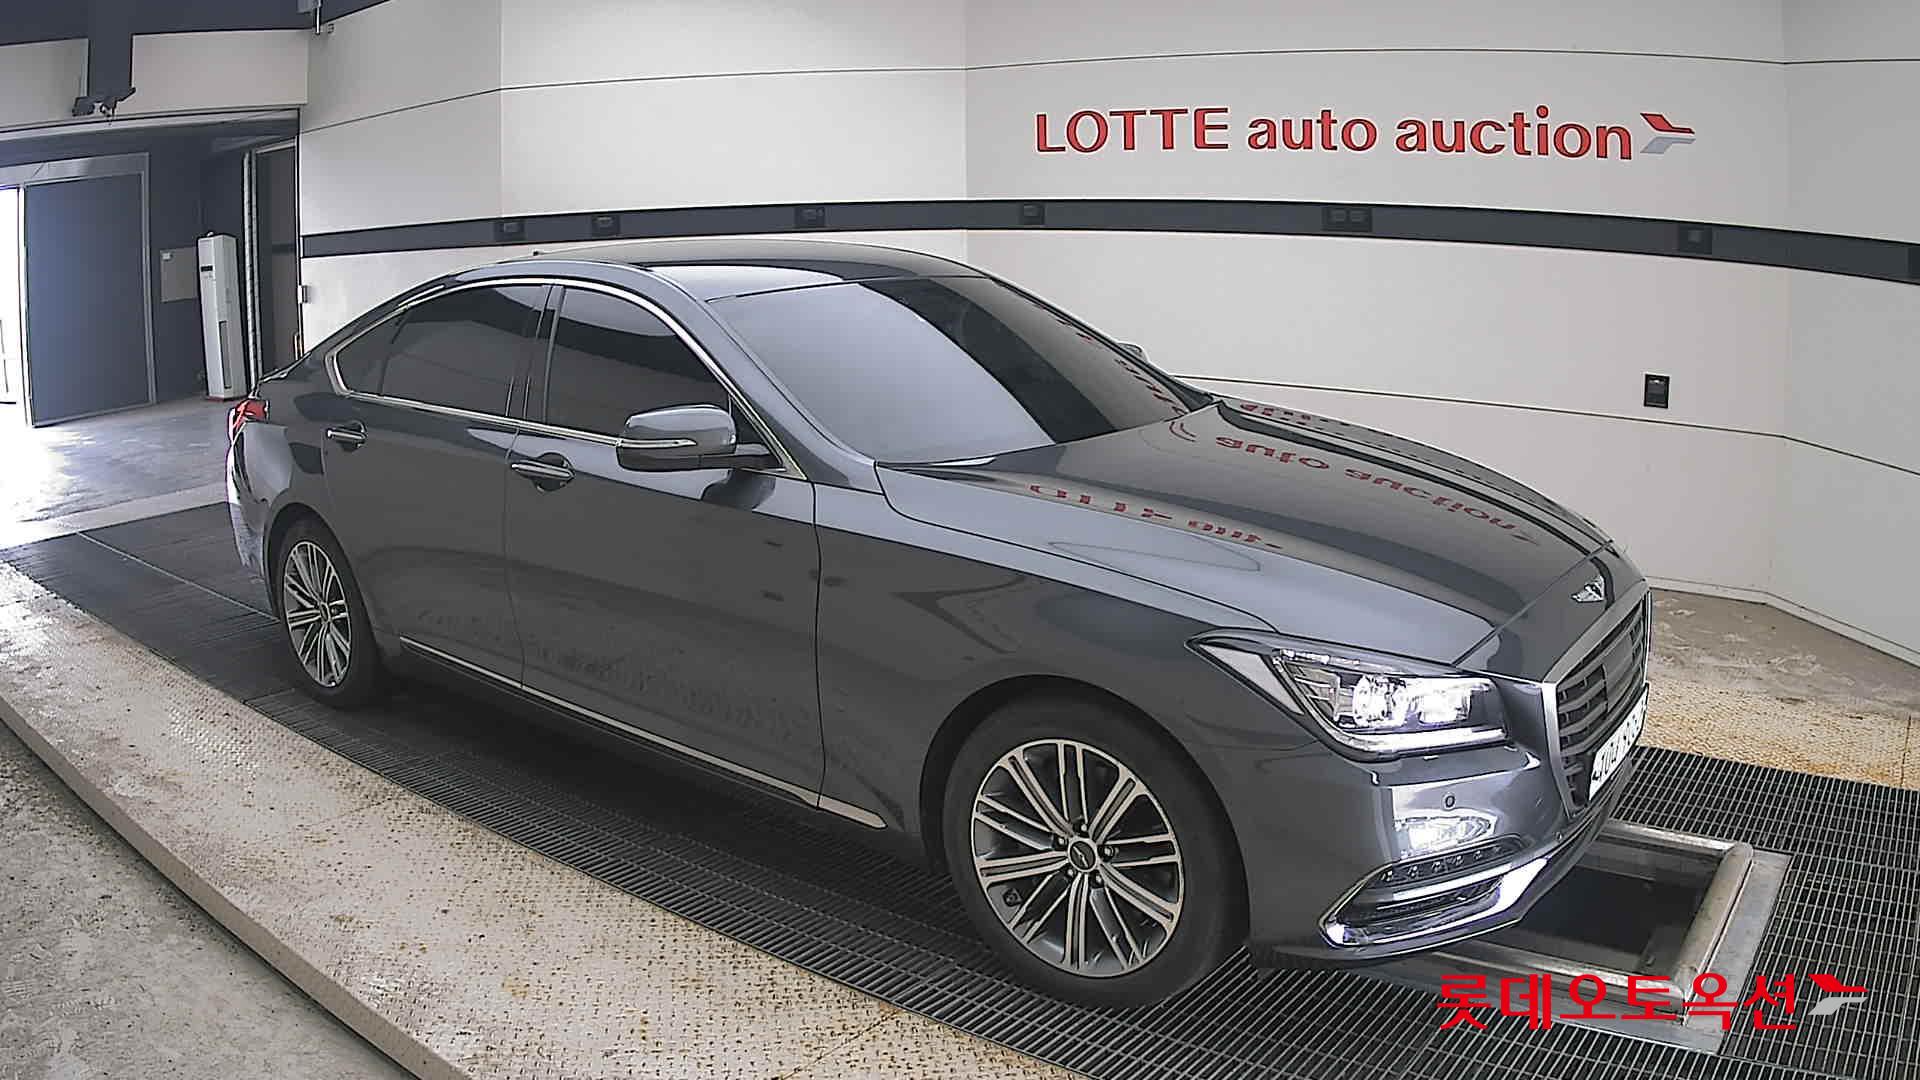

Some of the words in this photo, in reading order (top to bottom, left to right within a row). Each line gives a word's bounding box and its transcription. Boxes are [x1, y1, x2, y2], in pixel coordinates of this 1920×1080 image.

[1036, 108, 1228, 153] LOTTE
[1247, 110, 1378, 152] auto
[1395, 105, 1633, 160] auction
